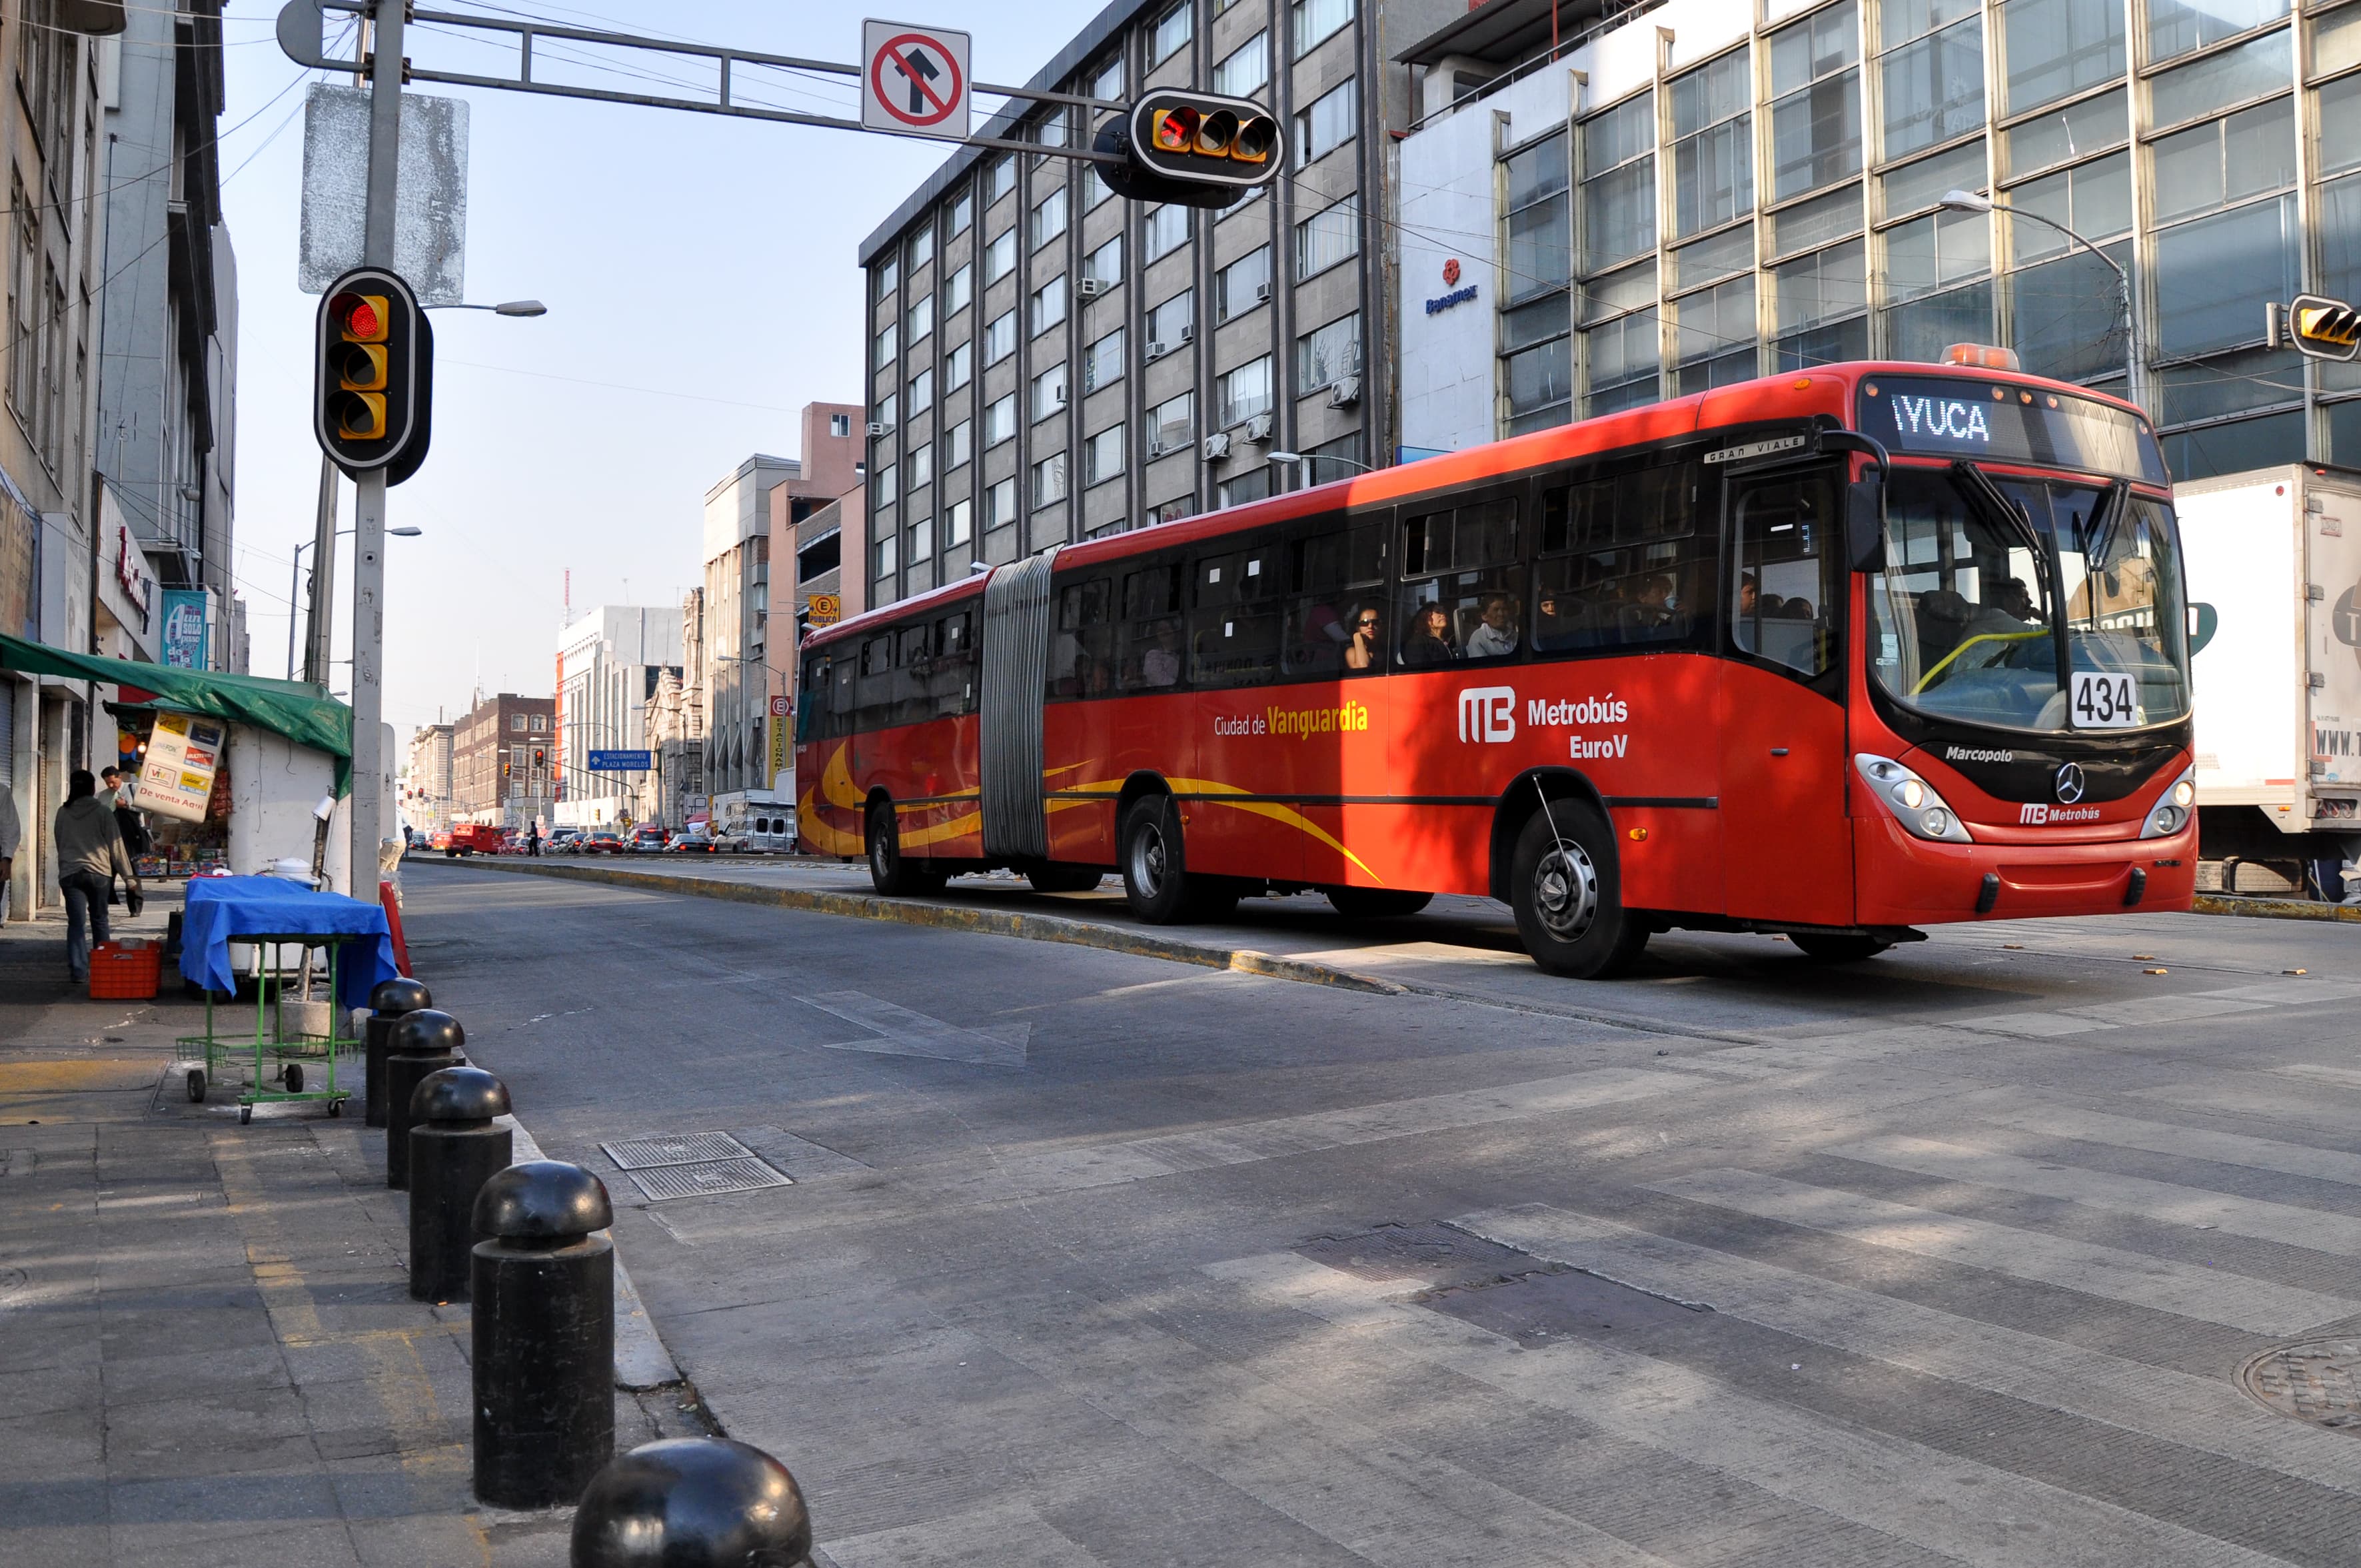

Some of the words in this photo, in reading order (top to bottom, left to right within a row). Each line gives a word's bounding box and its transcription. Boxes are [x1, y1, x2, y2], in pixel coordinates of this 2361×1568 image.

[1426, 285, 1477, 315] Banamex
[1710, 448, 1745, 461] GRAN
[1757, 437, 1799, 452] VIALE
[183, 623, 202, 635] SOLO
[1527, 692, 1628, 726] Metrobús
[2076, 677, 2132, 722] 434
[1214, 714, 1249, 736] Ciudad
[1251, 714, 1265, 735] de
[1267, 700, 1368, 741] Vanguardia
[1569, 734, 1628, 759] EuroV
[1946, 746, 2012, 763] Marcopolo
[139, 787, 153, 797] De
[155, 793, 181, 804] venta
[2049, 806, 2100, 822] Metrobús
